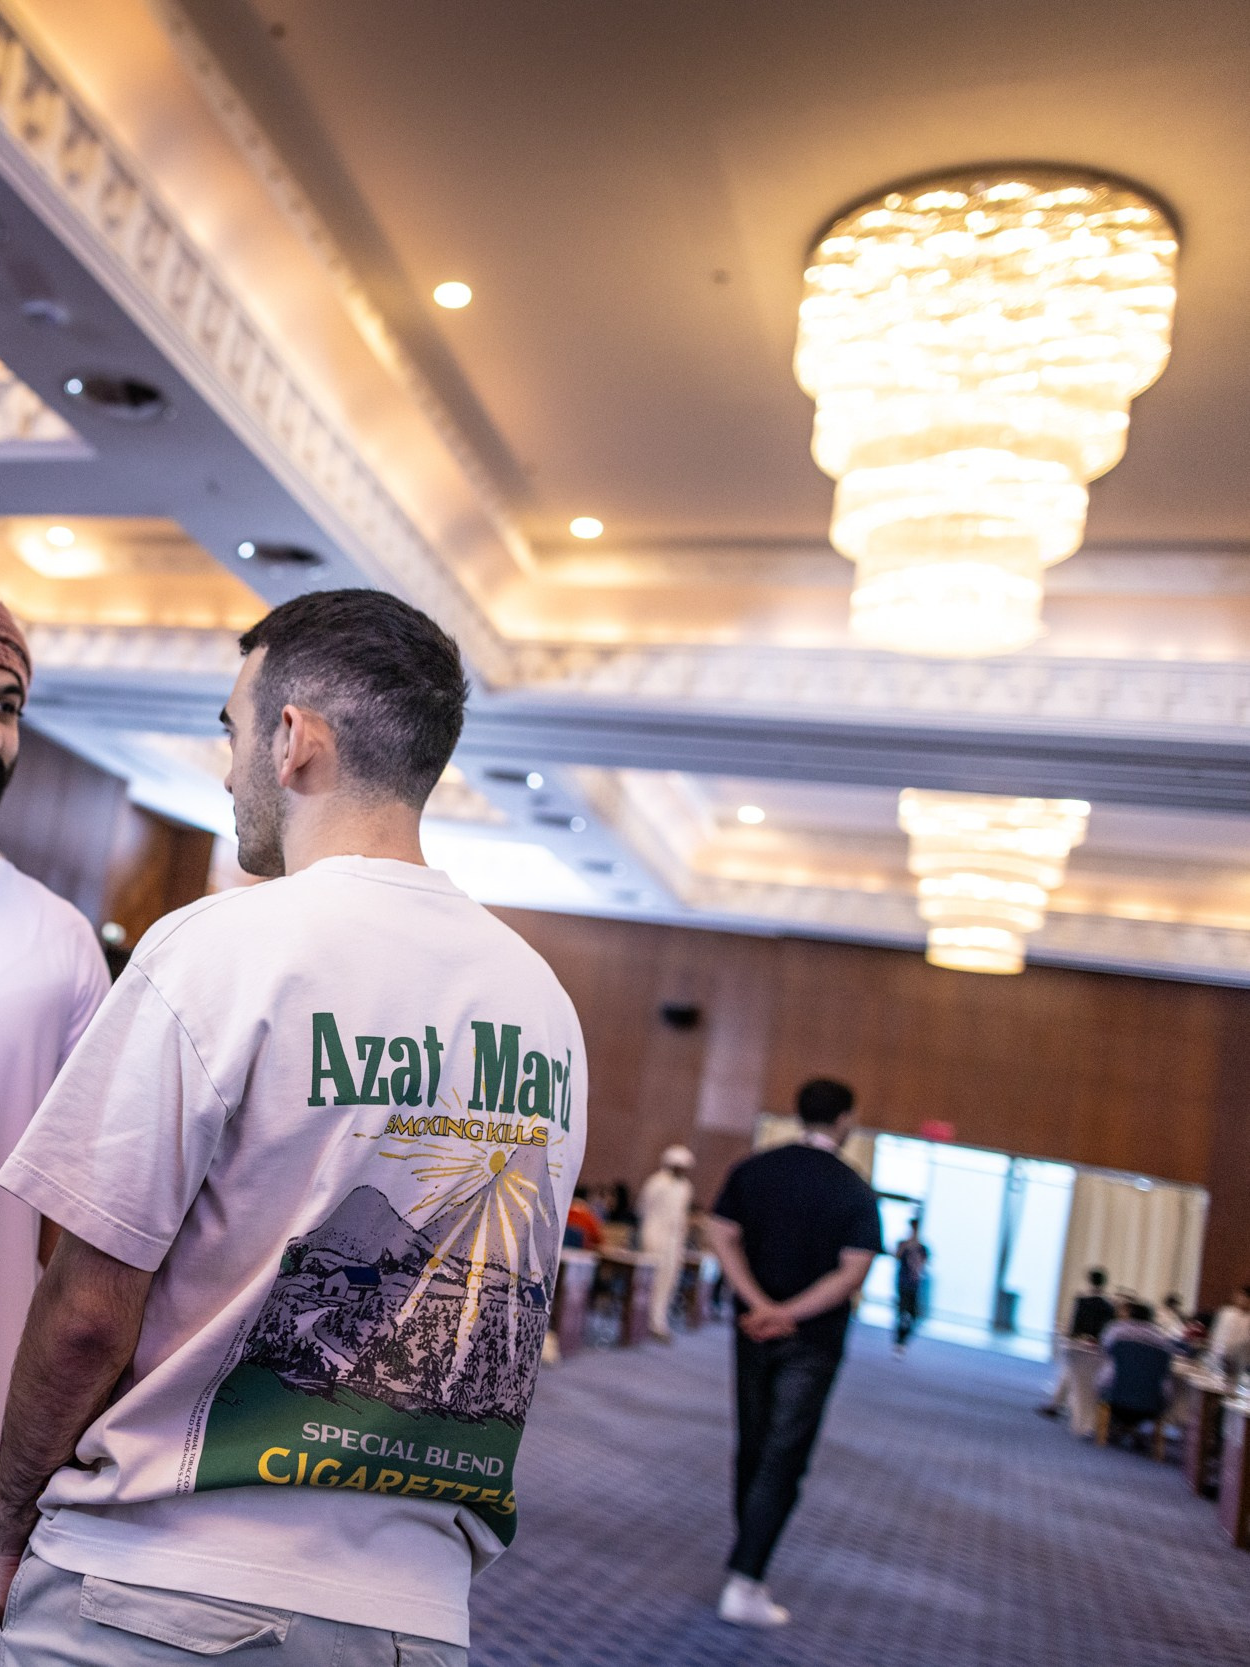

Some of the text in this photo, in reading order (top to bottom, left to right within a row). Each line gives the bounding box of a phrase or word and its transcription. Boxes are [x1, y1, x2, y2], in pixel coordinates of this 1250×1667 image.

[307, 1012, 572, 1133] Azat Mard
[384, 1113, 549, 1148] SMOKING KILLS
[198, 1400, 207, 1415] THE
[177, 1426, 194, 1477] TRADEMARKS
[191, 1415, 203, 1451] IMPERIAL
[301, 1421, 505, 1478] SPECIAL BLEND
[183, 1452, 196, 1489] TOBACCO
[257, 1446, 517, 1516] CIGARETTES
